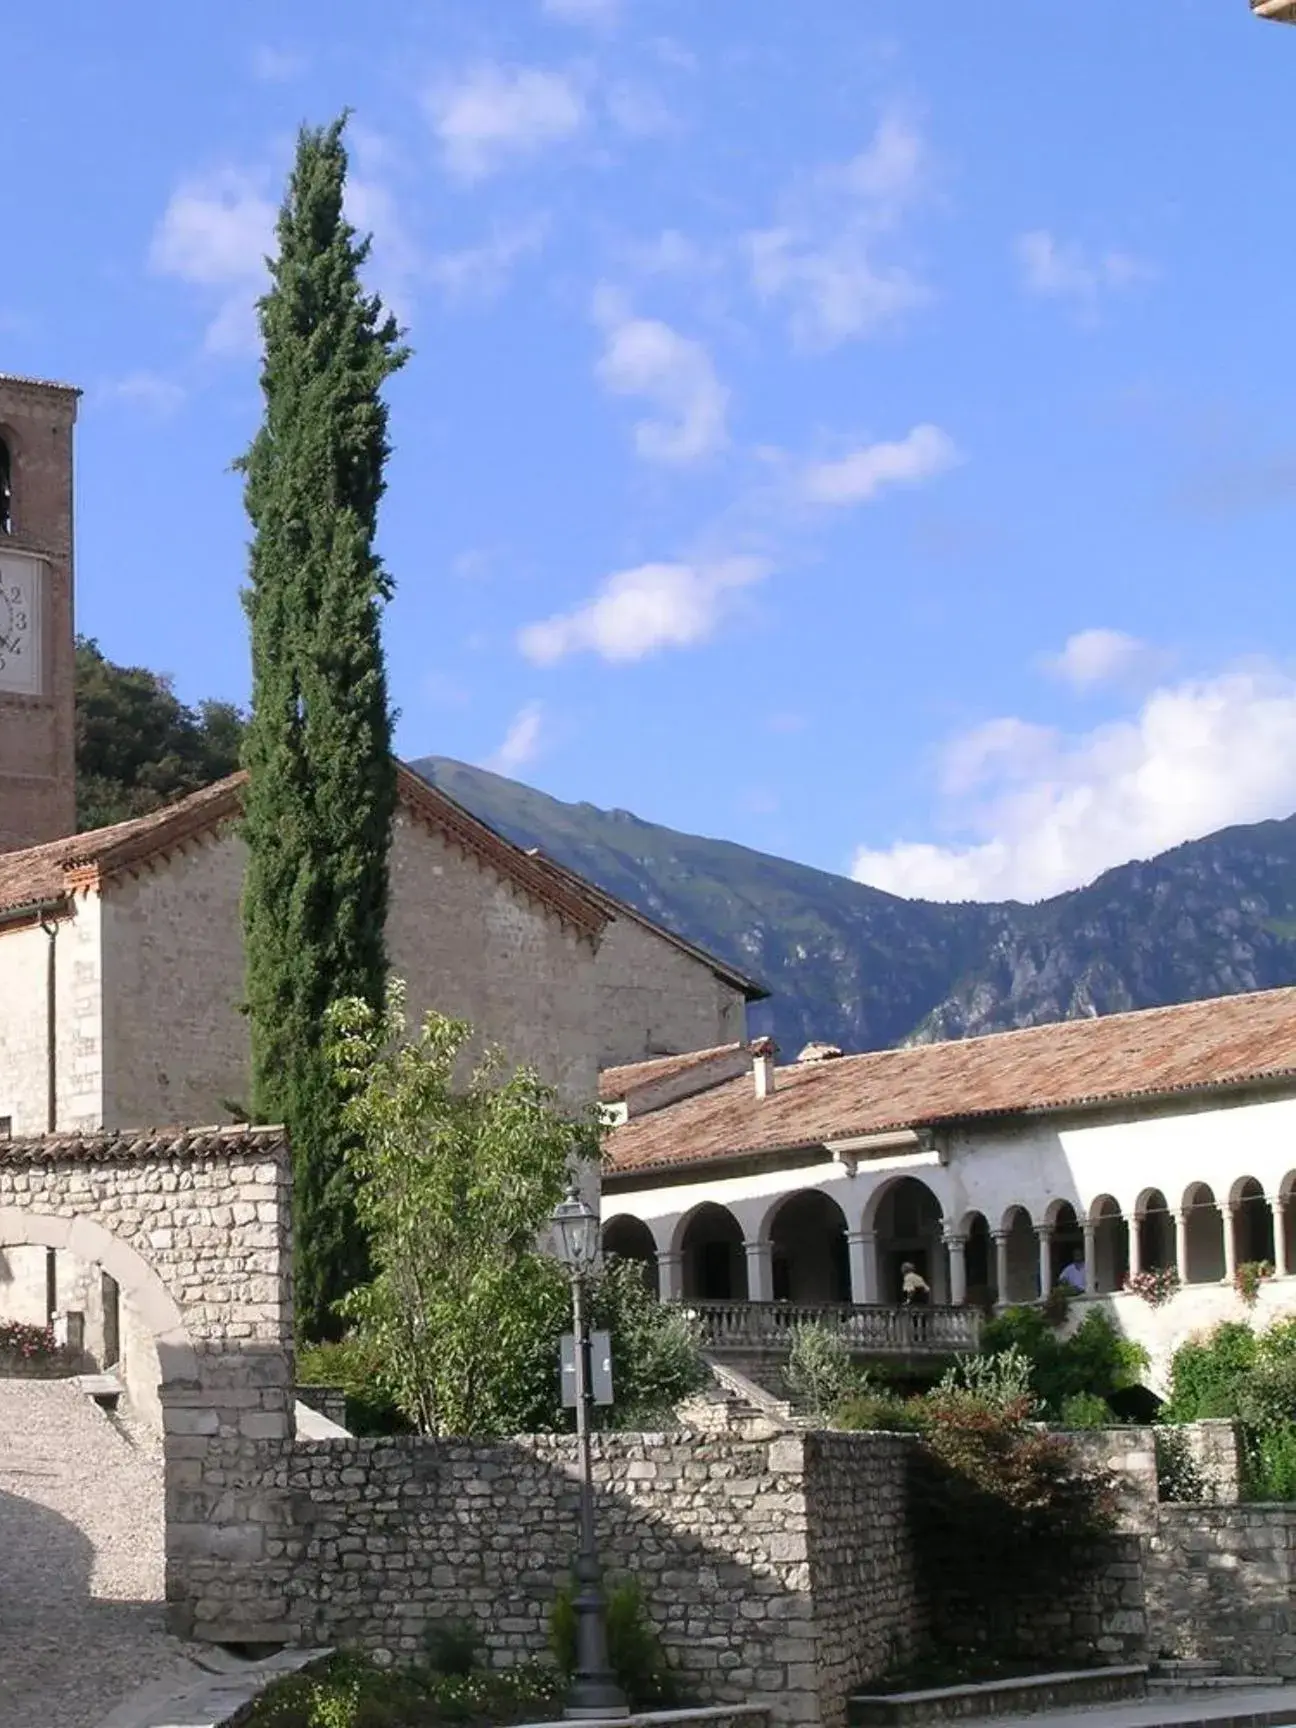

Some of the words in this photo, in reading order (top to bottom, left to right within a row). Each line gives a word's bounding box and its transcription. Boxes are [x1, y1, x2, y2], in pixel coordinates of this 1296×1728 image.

[10, 587, 22, 604] 2
[16, 613, 27, 630] 3
[6, 637, 21, 655] 4
